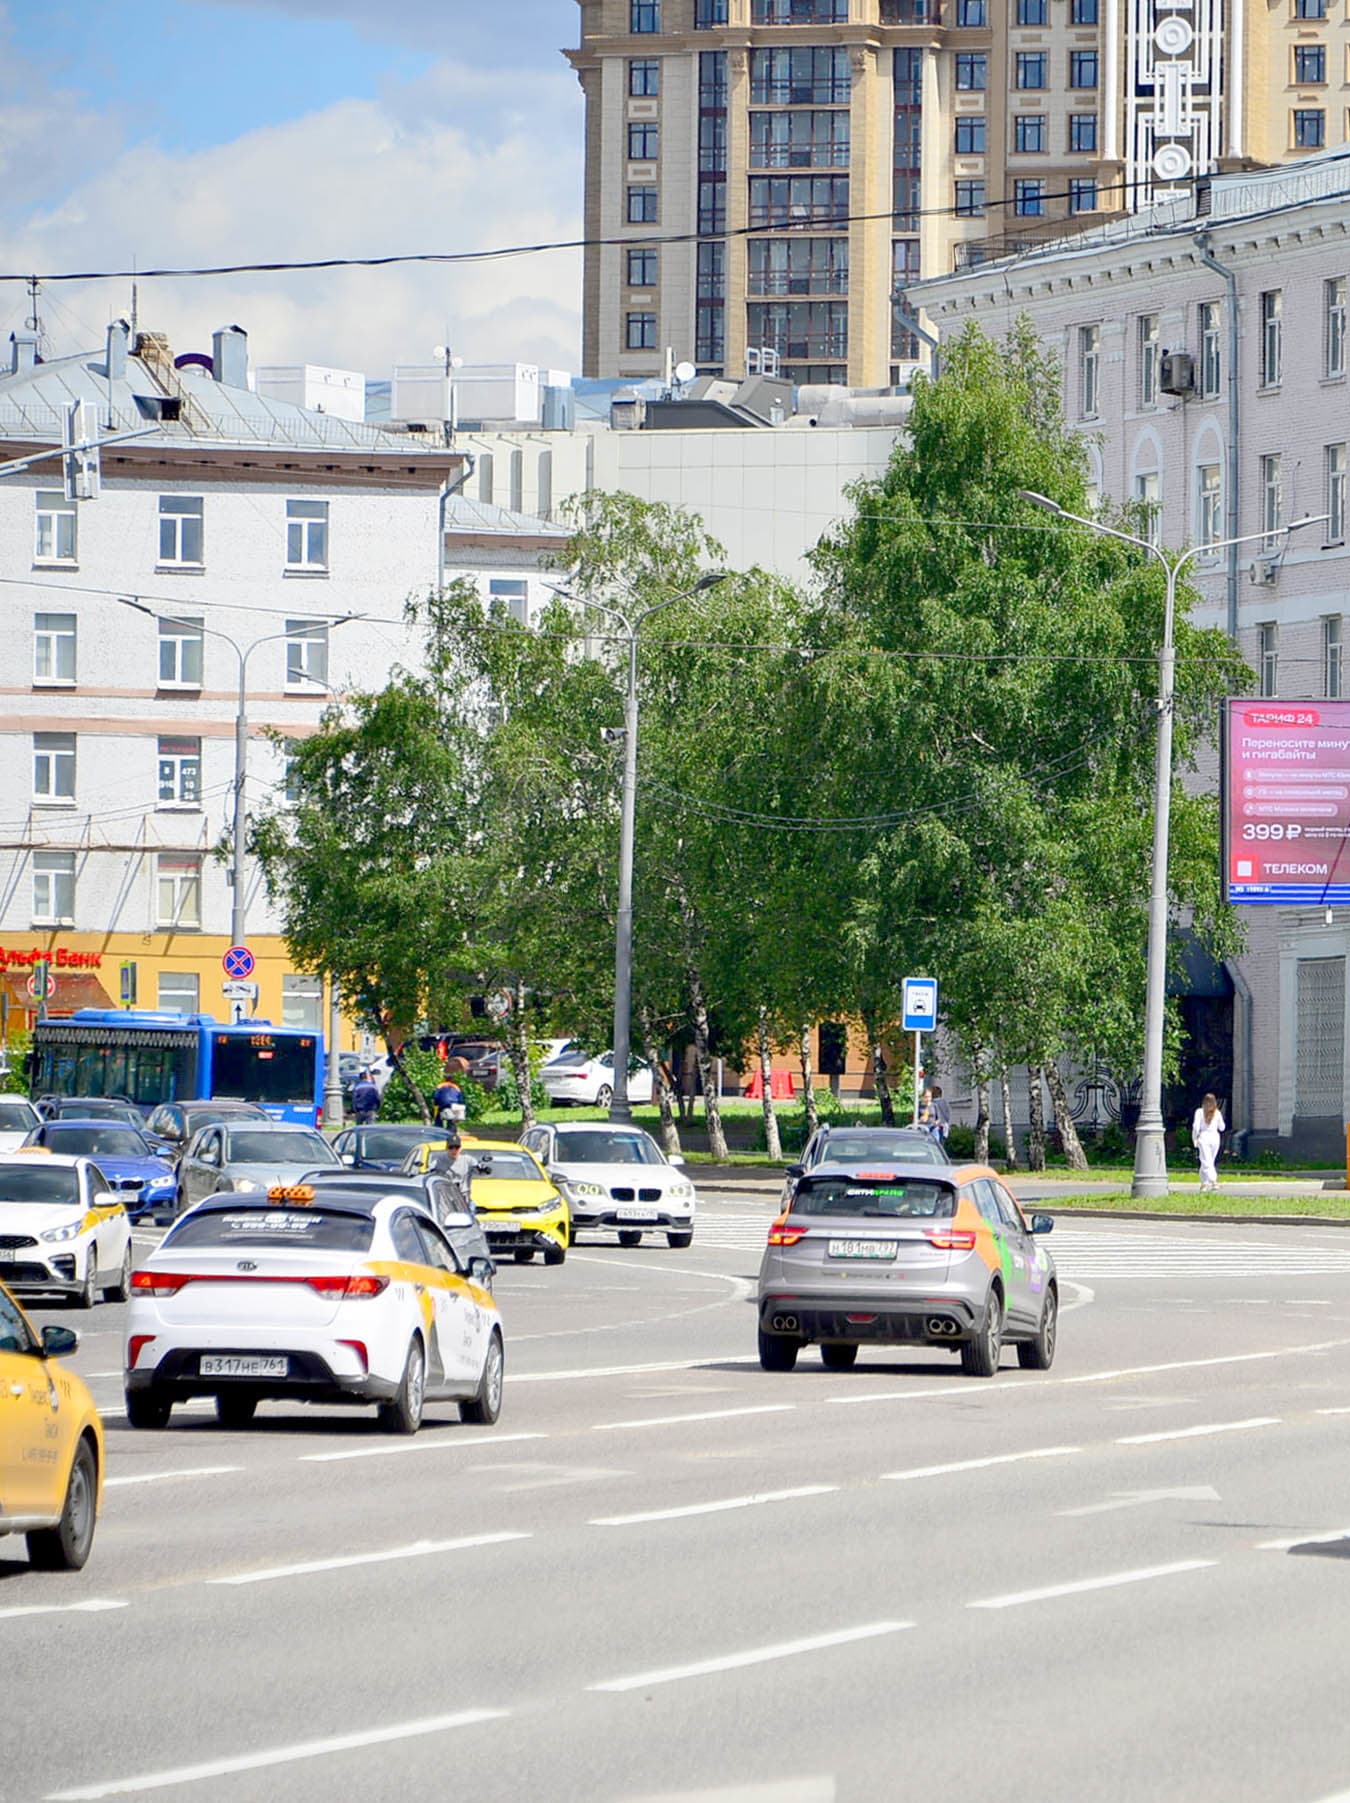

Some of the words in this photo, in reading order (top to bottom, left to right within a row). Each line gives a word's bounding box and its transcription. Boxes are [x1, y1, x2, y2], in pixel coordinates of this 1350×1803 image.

[1251, 713, 1295, 724] ТАРИФ
[1297, 714, 1313, 724] 24
[1242, 738, 1316, 750] Переносите
[1252, 750, 1316, 760] гигабайты
[1242, 824, 1284, 840] 399
[1263, 863, 1328, 875] ТЕЛЕКОМ
[56, 948, 103, 968] Банк
